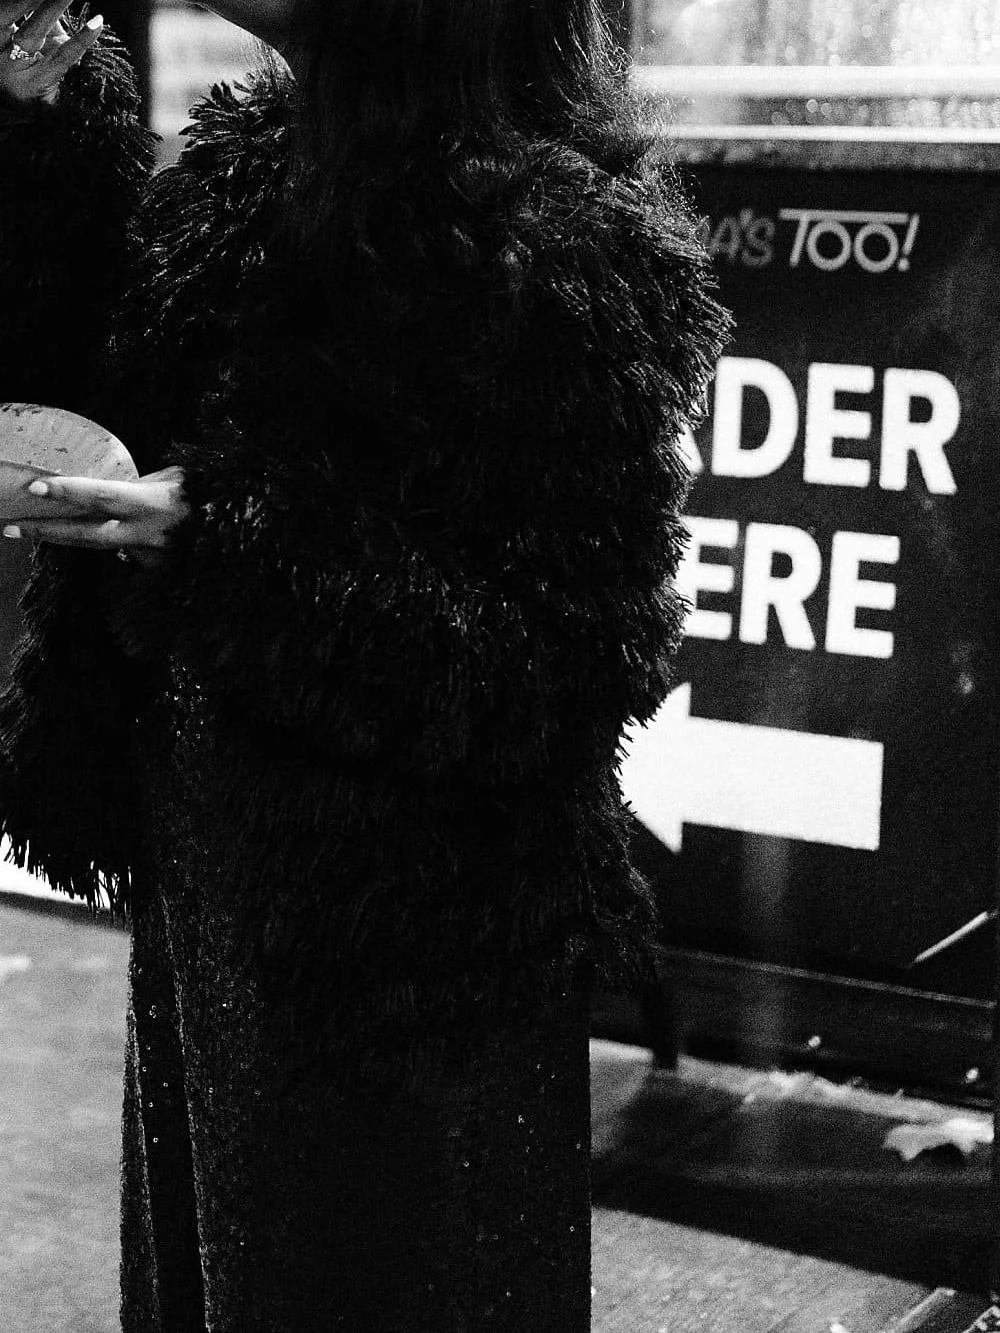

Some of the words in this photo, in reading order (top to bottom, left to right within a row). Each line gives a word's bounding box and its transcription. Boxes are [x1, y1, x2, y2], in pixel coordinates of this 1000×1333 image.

[702, 208, 775, 267] A'S
[777, 207, 920, 273] TOO!
[676, 357, 961, 495] DER
[676, 515, 901, 659] ERE
